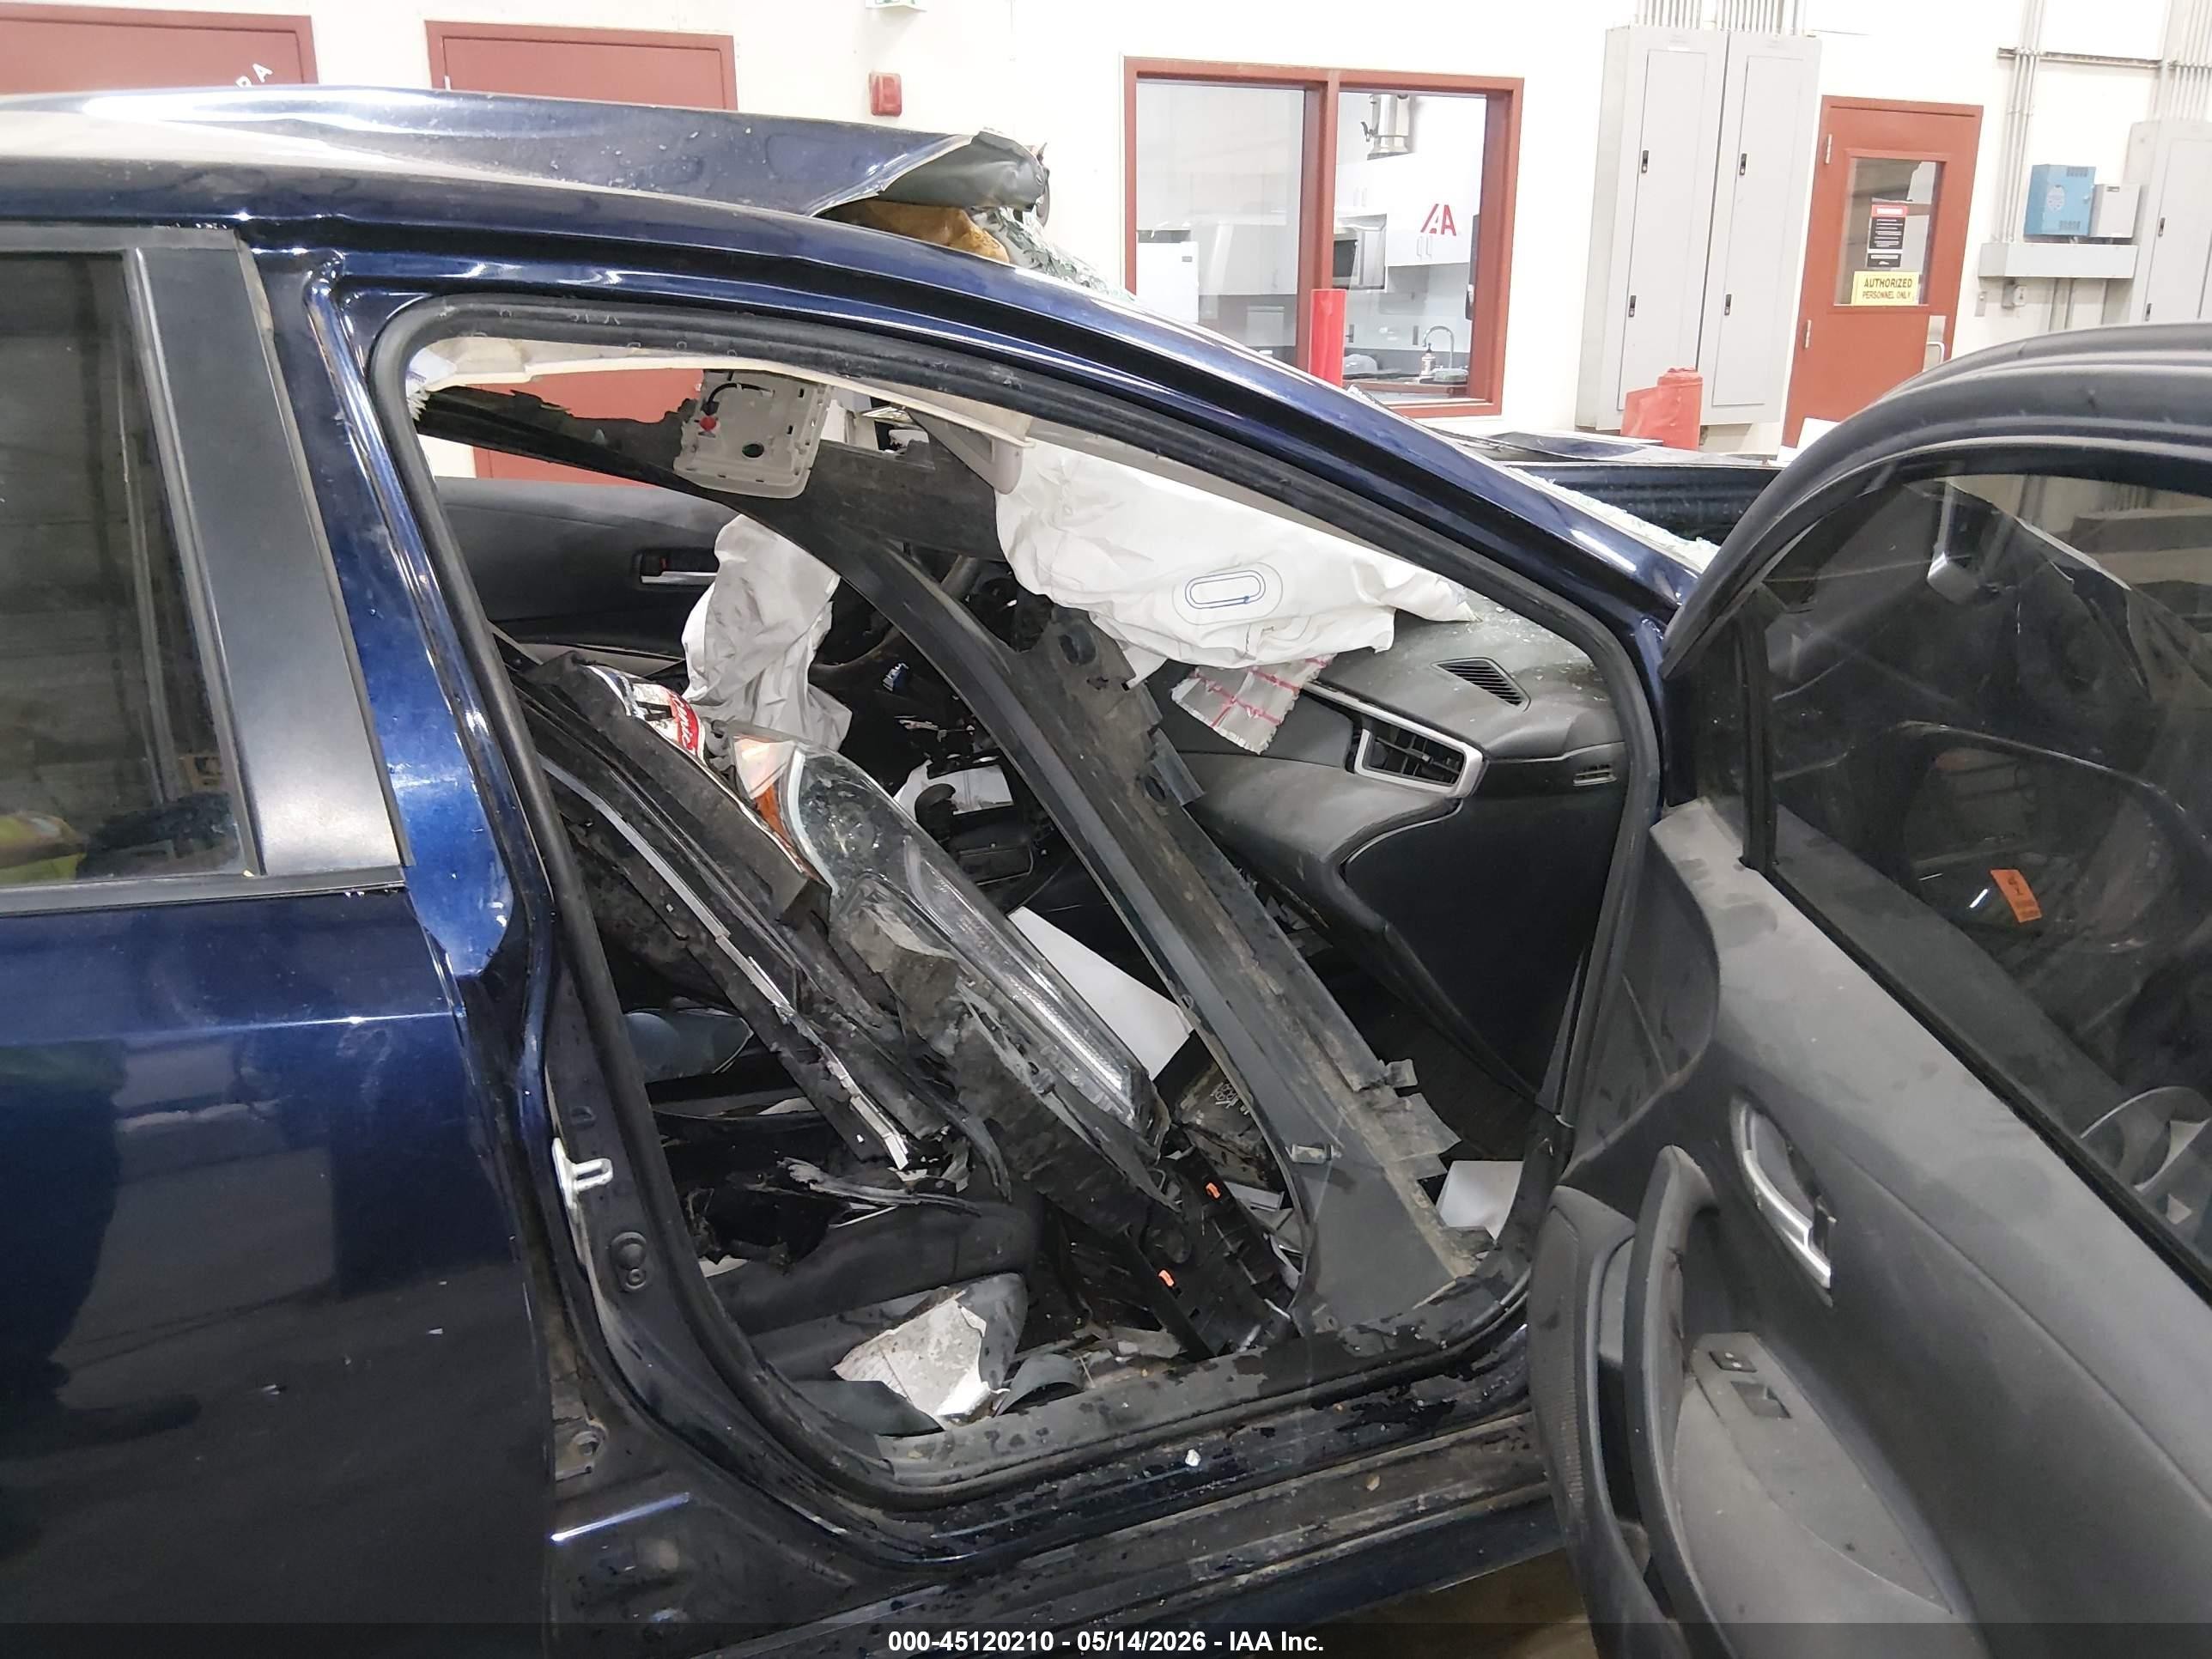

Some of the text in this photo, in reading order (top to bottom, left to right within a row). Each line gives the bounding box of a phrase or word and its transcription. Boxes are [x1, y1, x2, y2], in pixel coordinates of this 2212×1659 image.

[1863, 278, 1913, 289] AUTHORIZED
[1862, 290, 1911, 300] PERSONNEL ONLY
